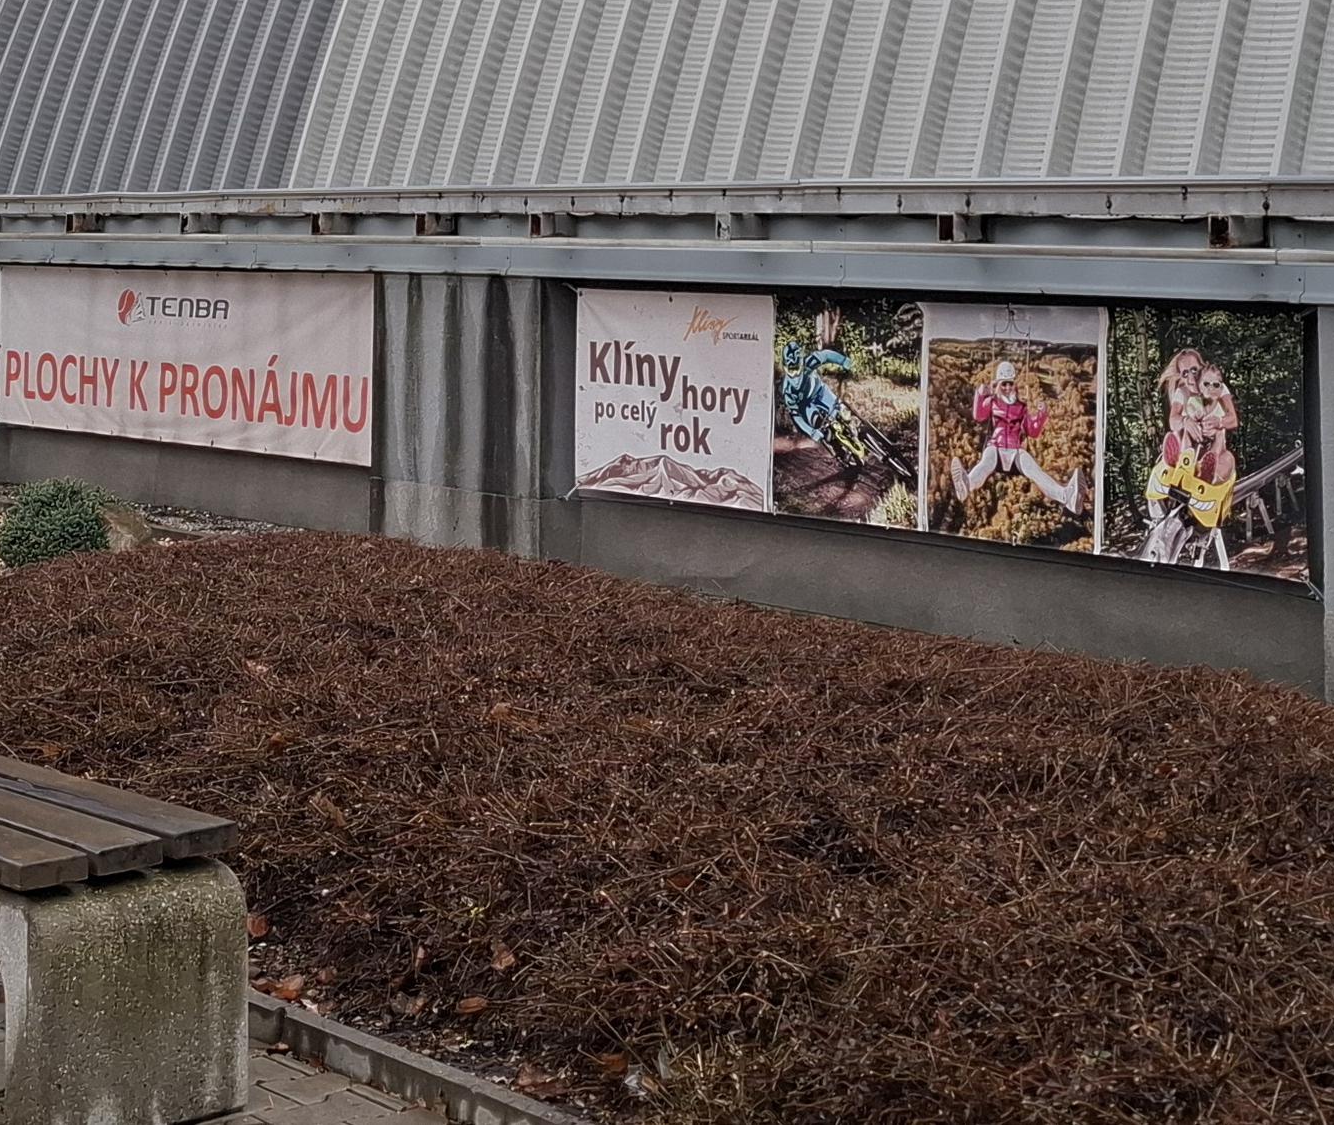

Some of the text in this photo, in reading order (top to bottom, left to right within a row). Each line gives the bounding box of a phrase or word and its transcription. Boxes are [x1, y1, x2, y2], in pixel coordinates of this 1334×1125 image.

[146, 296, 230, 320] TENBA
[5, 350, 369, 434] PLOCHY K PRONÁJMU
[589, 340, 681, 402] Klíny
[595, 400, 657, 429] po celý
[682, 375, 750, 424] hory
[660, 416, 712, 456] rok
